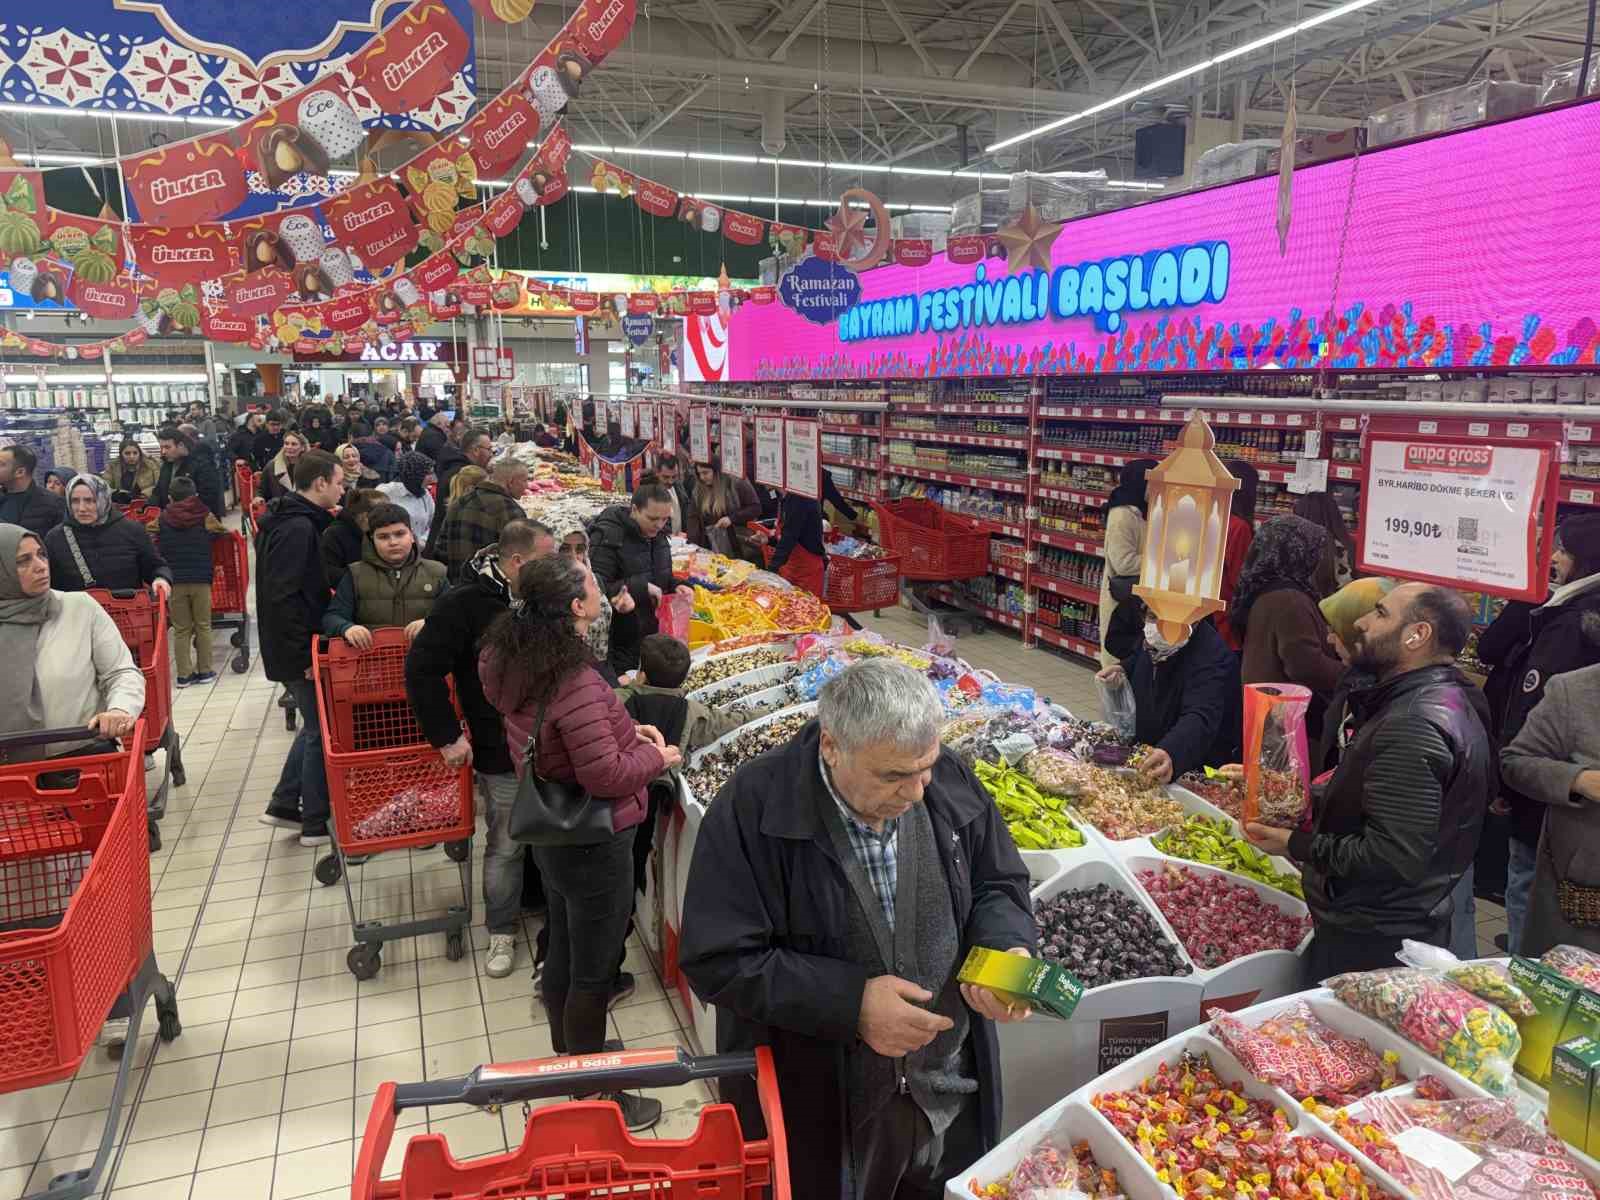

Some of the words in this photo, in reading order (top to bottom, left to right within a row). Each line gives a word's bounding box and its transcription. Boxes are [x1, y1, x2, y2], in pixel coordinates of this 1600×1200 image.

[588, 0, 625, 40] ÜLKER
[382, 32, 448, 91] ÜLKER
[306, 99, 335, 118] Ece
[484, 112, 527, 149] ÜLKER
[150, 169, 226, 205] ÜLKER
[286, 219, 309, 231] Ece
[344, 201, 395, 232] ÜLKER
[152, 244, 215, 264] ÜLKER
[786, 275, 855, 292] Ramazan
[1057, 241, 1230, 334] BAŞLADI
[84, 287, 126, 307] ÜLKER
[236, 284, 277, 304] ÜLKER
[792, 292, 848, 307] Festivali
[360, 342, 440, 361] ACAR
[1408, 446, 1446, 464] anpa
[1448, 449, 1489, 466] gross
[1430, 482, 1463, 496] DÖKME
[1464, 486, 1497, 499] ŞEKER
